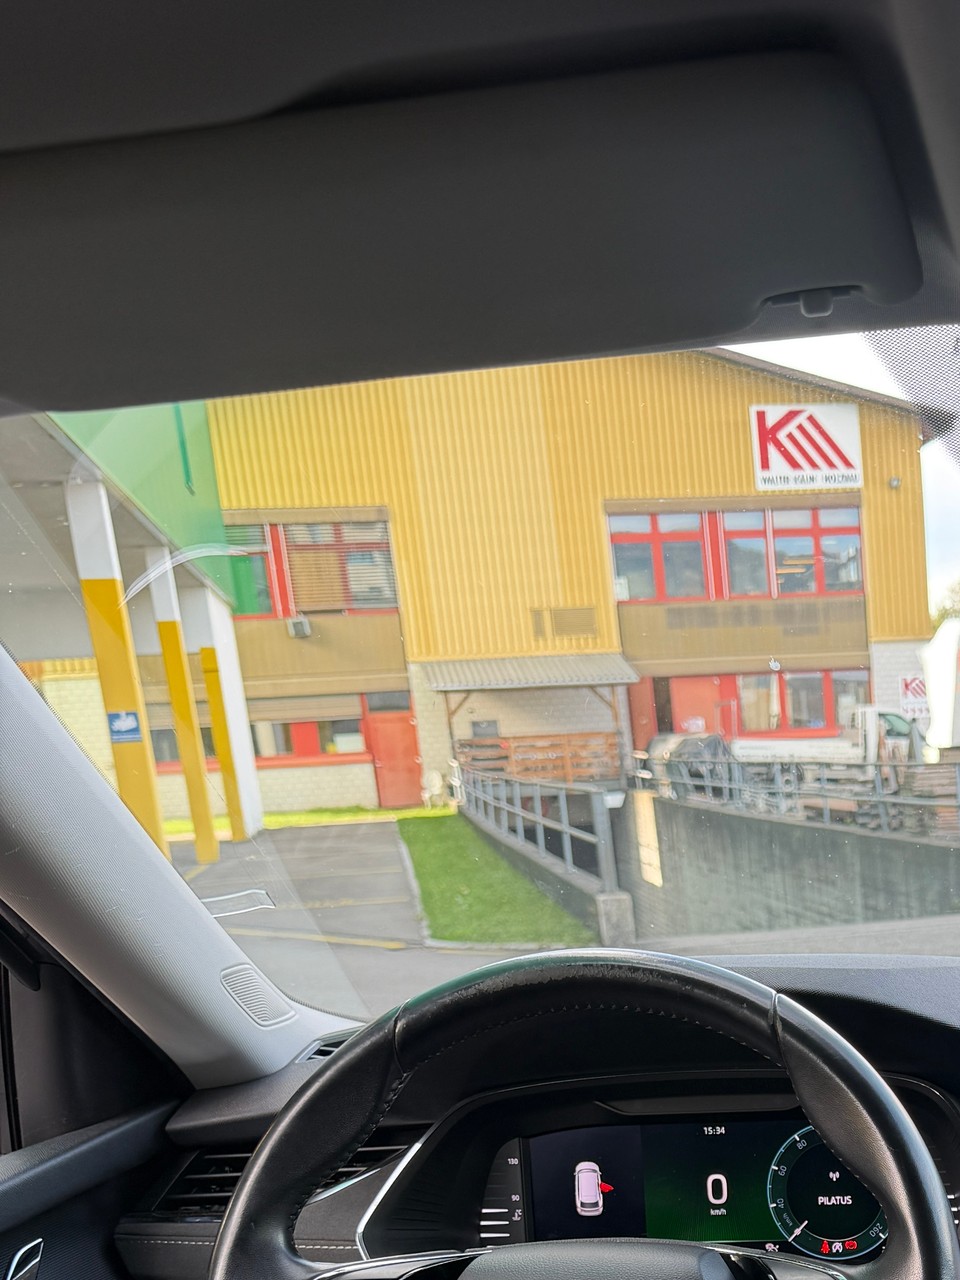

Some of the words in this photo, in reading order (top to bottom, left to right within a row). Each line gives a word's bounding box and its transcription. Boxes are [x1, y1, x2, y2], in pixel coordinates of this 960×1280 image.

[703, 1126, 726, 1135] 15:34
[796, 1140, 807, 1150] 80
[778, 1165, 787, 1176] 60
[706, 1173, 728, 1205] 0
[511, 1194, 520, 1202] 90
[818, 1195, 853, 1205] PILATUS
[776, 1198, 785, 1209] 40
[709, 1208, 727, 1216] km/h
